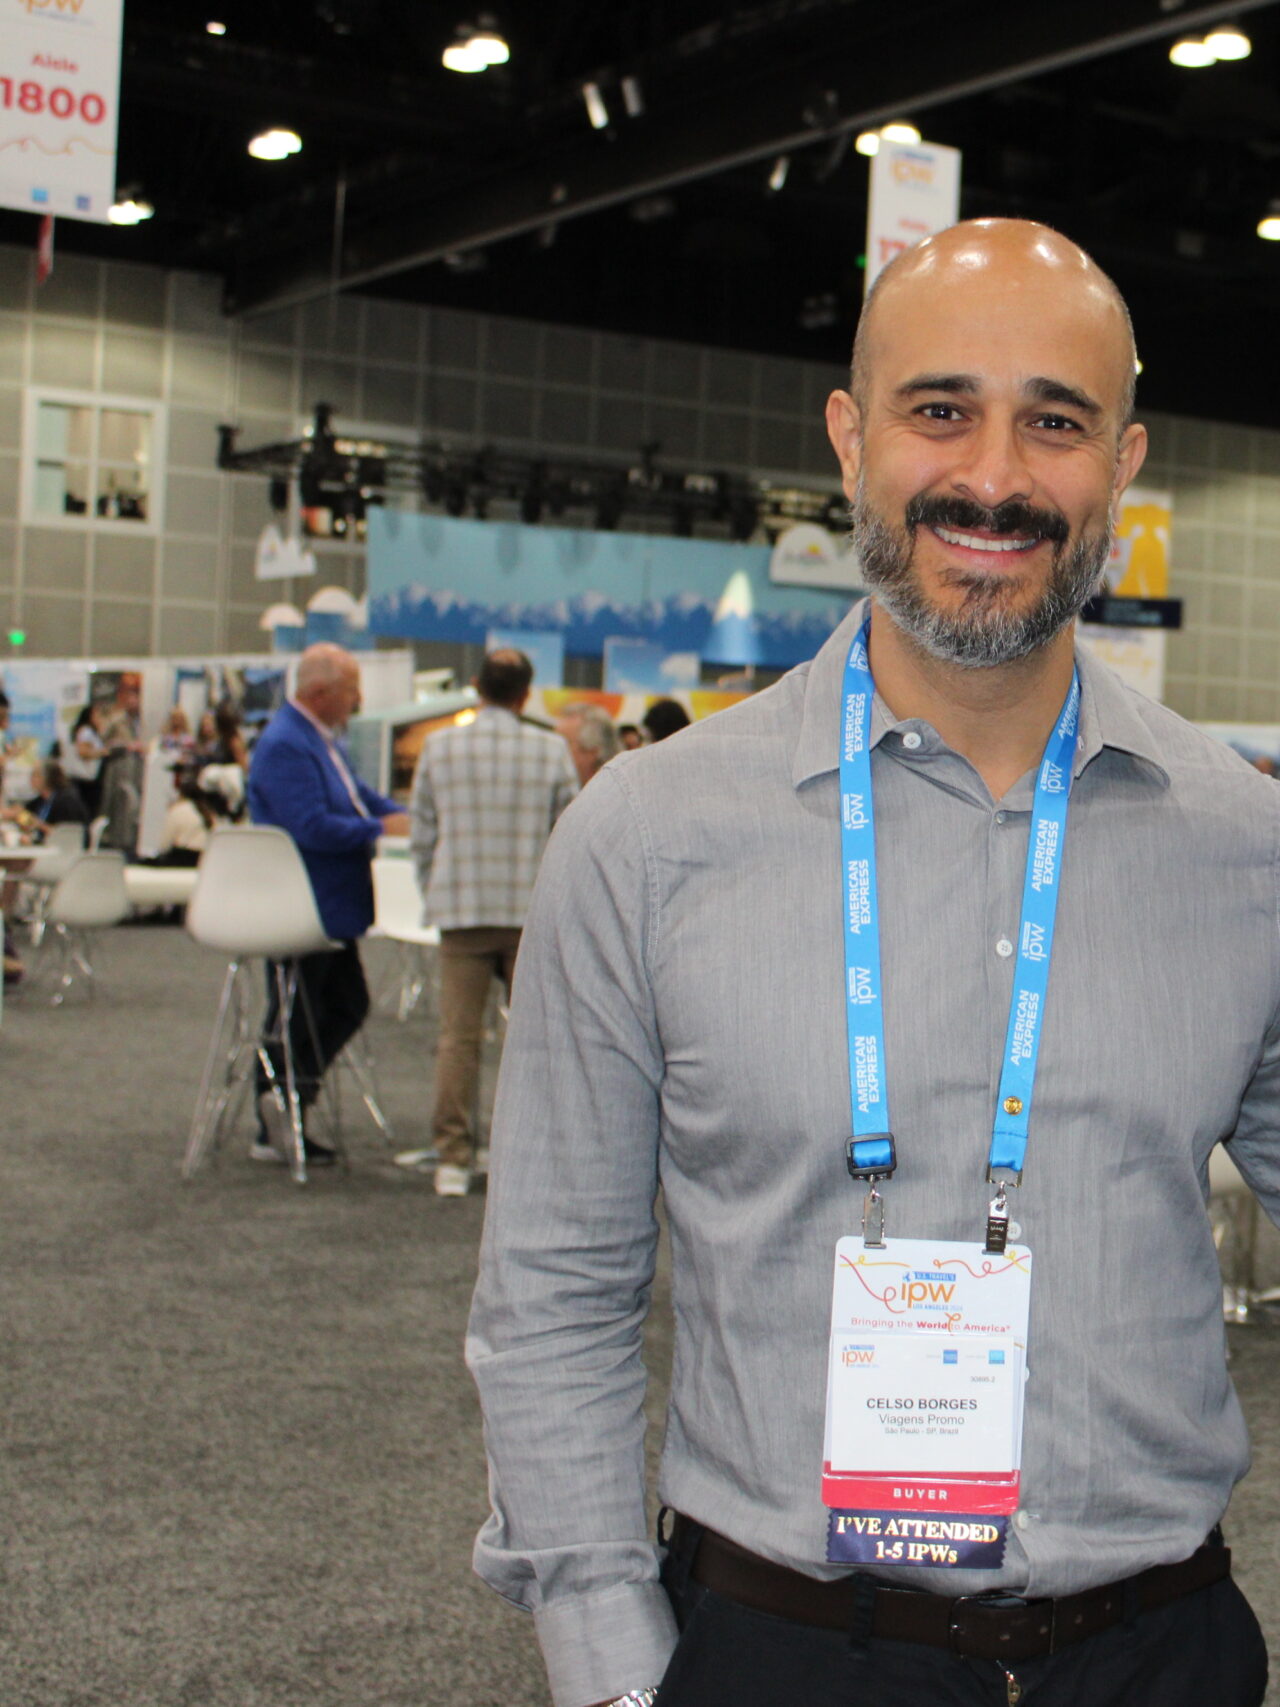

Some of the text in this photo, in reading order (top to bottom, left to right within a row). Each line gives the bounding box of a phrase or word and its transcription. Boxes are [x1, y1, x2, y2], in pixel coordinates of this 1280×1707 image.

[0, 76, 107, 125] 1800
[845, 693, 857, 762] AMERICAN
[854, 692, 866, 752] EXPRESS
[1047, 762, 1065, 794] ipw
[851, 793, 870, 829] ipw
[1031, 819, 1049, 892] AMERICAN
[1042, 820, 1059, 885] EXPRESS
[848, 860, 861, 935] AMERICAN
[859, 859, 871, 925] EXPRESS
[1029, 923, 1047, 962] ipw
[858, 967, 877, 1004] ipw
[1011, 990, 1029, 1066] AMERICAN
[1021, 992, 1040, 1058] EXPRESS
[858, 1036, 869, 1113] AMERICAN
[868, 1035, 877, 1103] EXPRESS
[901, 1282, 956, 1309] ipw
[851, 1317, 894, 1329] Bringing
[897, 1318, 913, 1328] the
[916, 1320, 948, 1330] World
[842, 1351, 874, 1368] ipw
[866, 1398, 978, 1410] CELSO BORGES
[879, 1414, 965, 1426] Viagens Promo
[900, 1426, 920, 1434] Paulo
[939, 1427, 959, 1435] Brazil
[893, 1487, 948, 1500] BUYER
[837, 1516, 999, 1542] I'VE ATTENDED
[876, 1541, 958, 1563] 1-5 IPWs
